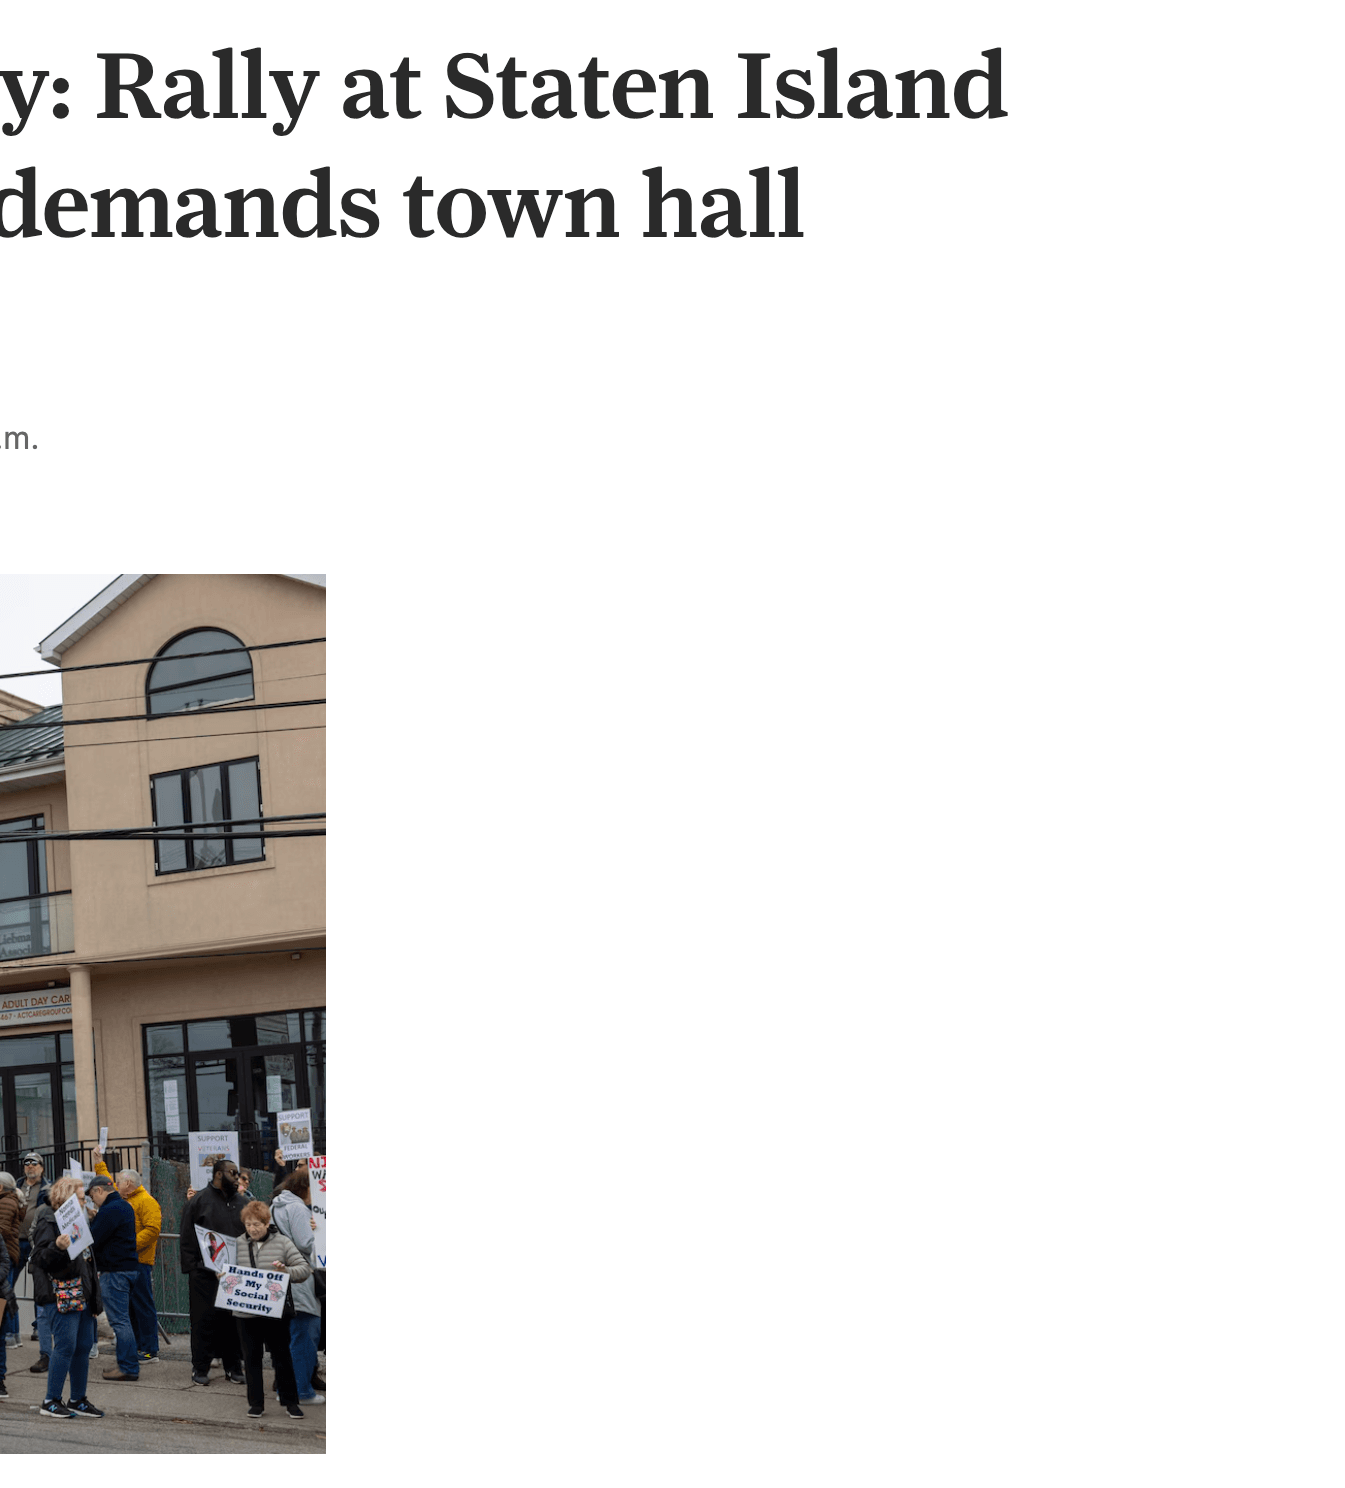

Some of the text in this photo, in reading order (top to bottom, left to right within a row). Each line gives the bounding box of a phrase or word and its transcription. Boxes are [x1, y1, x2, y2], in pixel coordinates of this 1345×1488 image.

[2, 999, 28, 1010] ADULT
[31, 996, 48, 1006] DAY
[278, 1112, 308, 1121] SUPPORT
[283, 1152, 310, 1160] WORKERS
[228, 1266, 284, 1281] Hands Off
[245, 1280, 262, 1290] My
[234, 1289, 269, 1301] Social
[226, 1298, 272, 1314] Security
